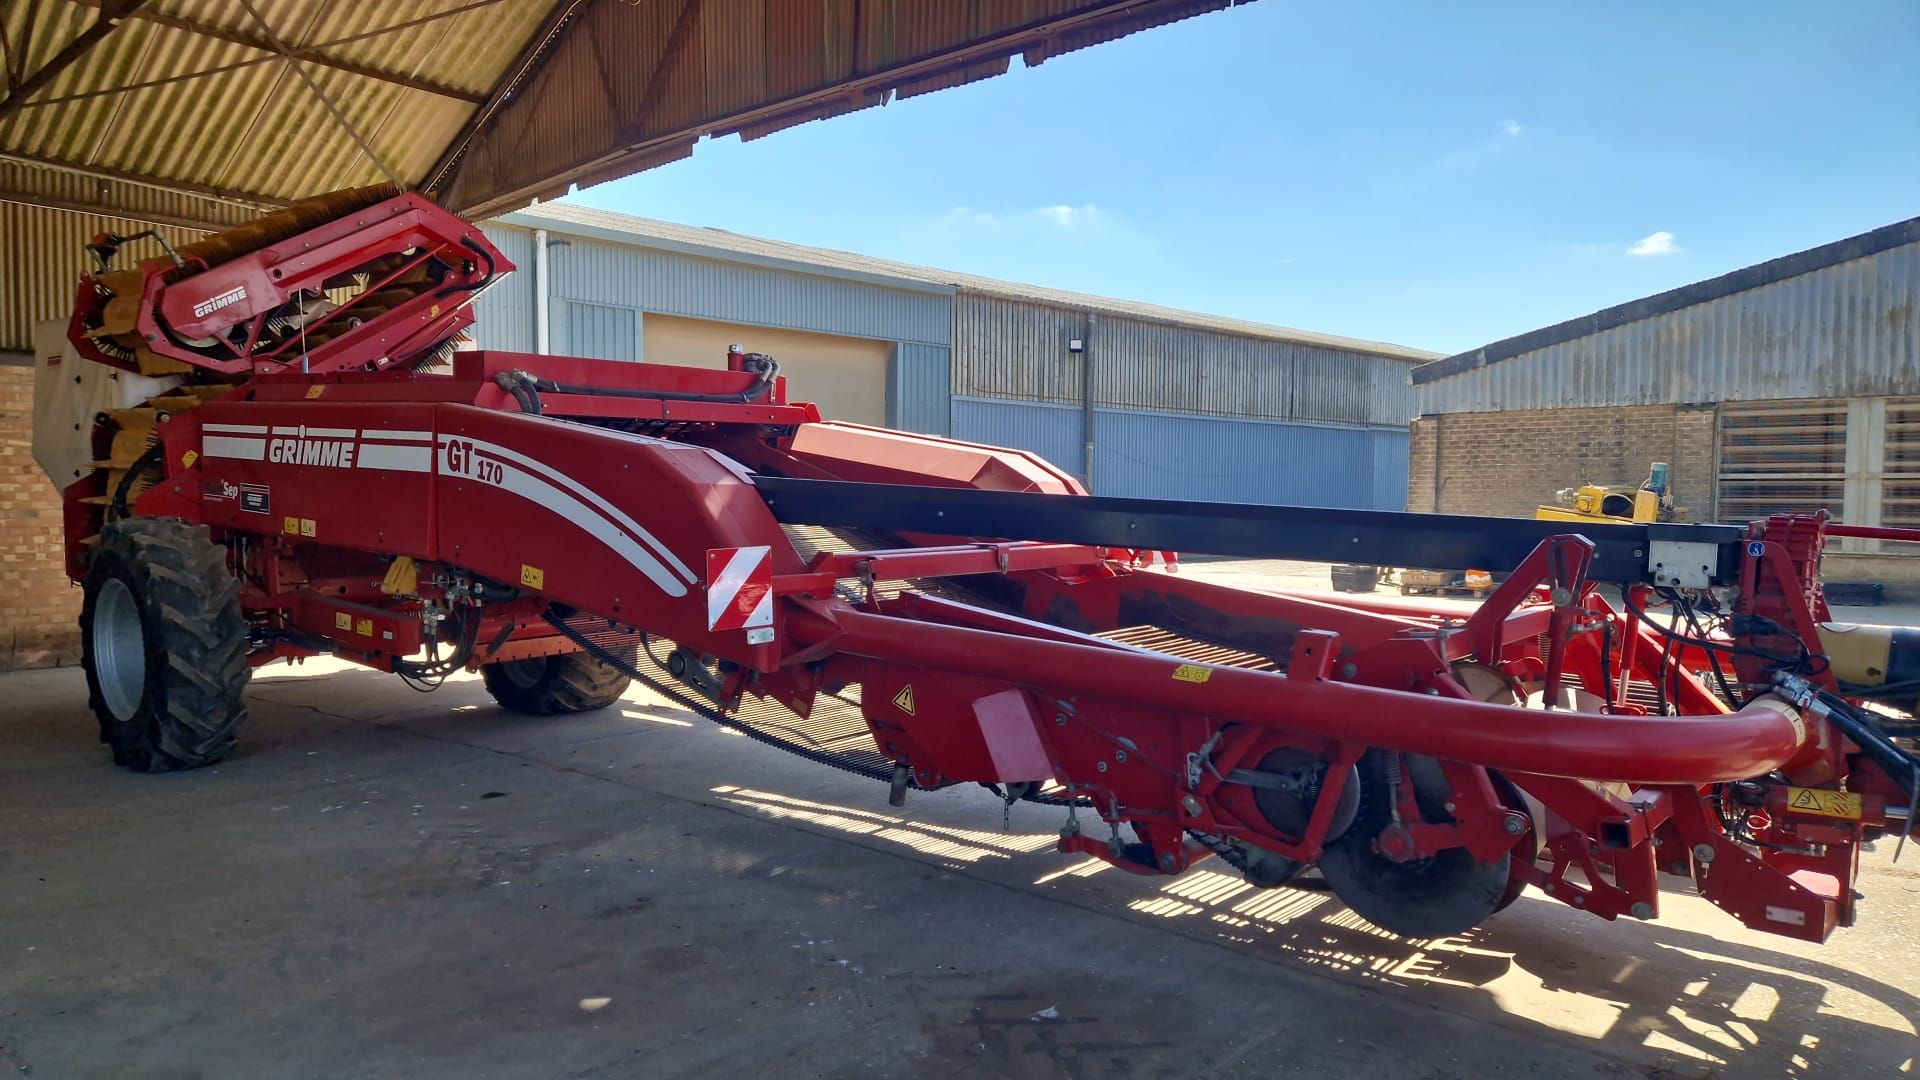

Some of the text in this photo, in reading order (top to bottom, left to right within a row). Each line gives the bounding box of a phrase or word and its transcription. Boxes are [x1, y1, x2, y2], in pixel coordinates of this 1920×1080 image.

[195, 289, 247, 318] GRIMME
[269, 425, 355, 469] GRIMME
[447, 439, 503, 485] GT 170
